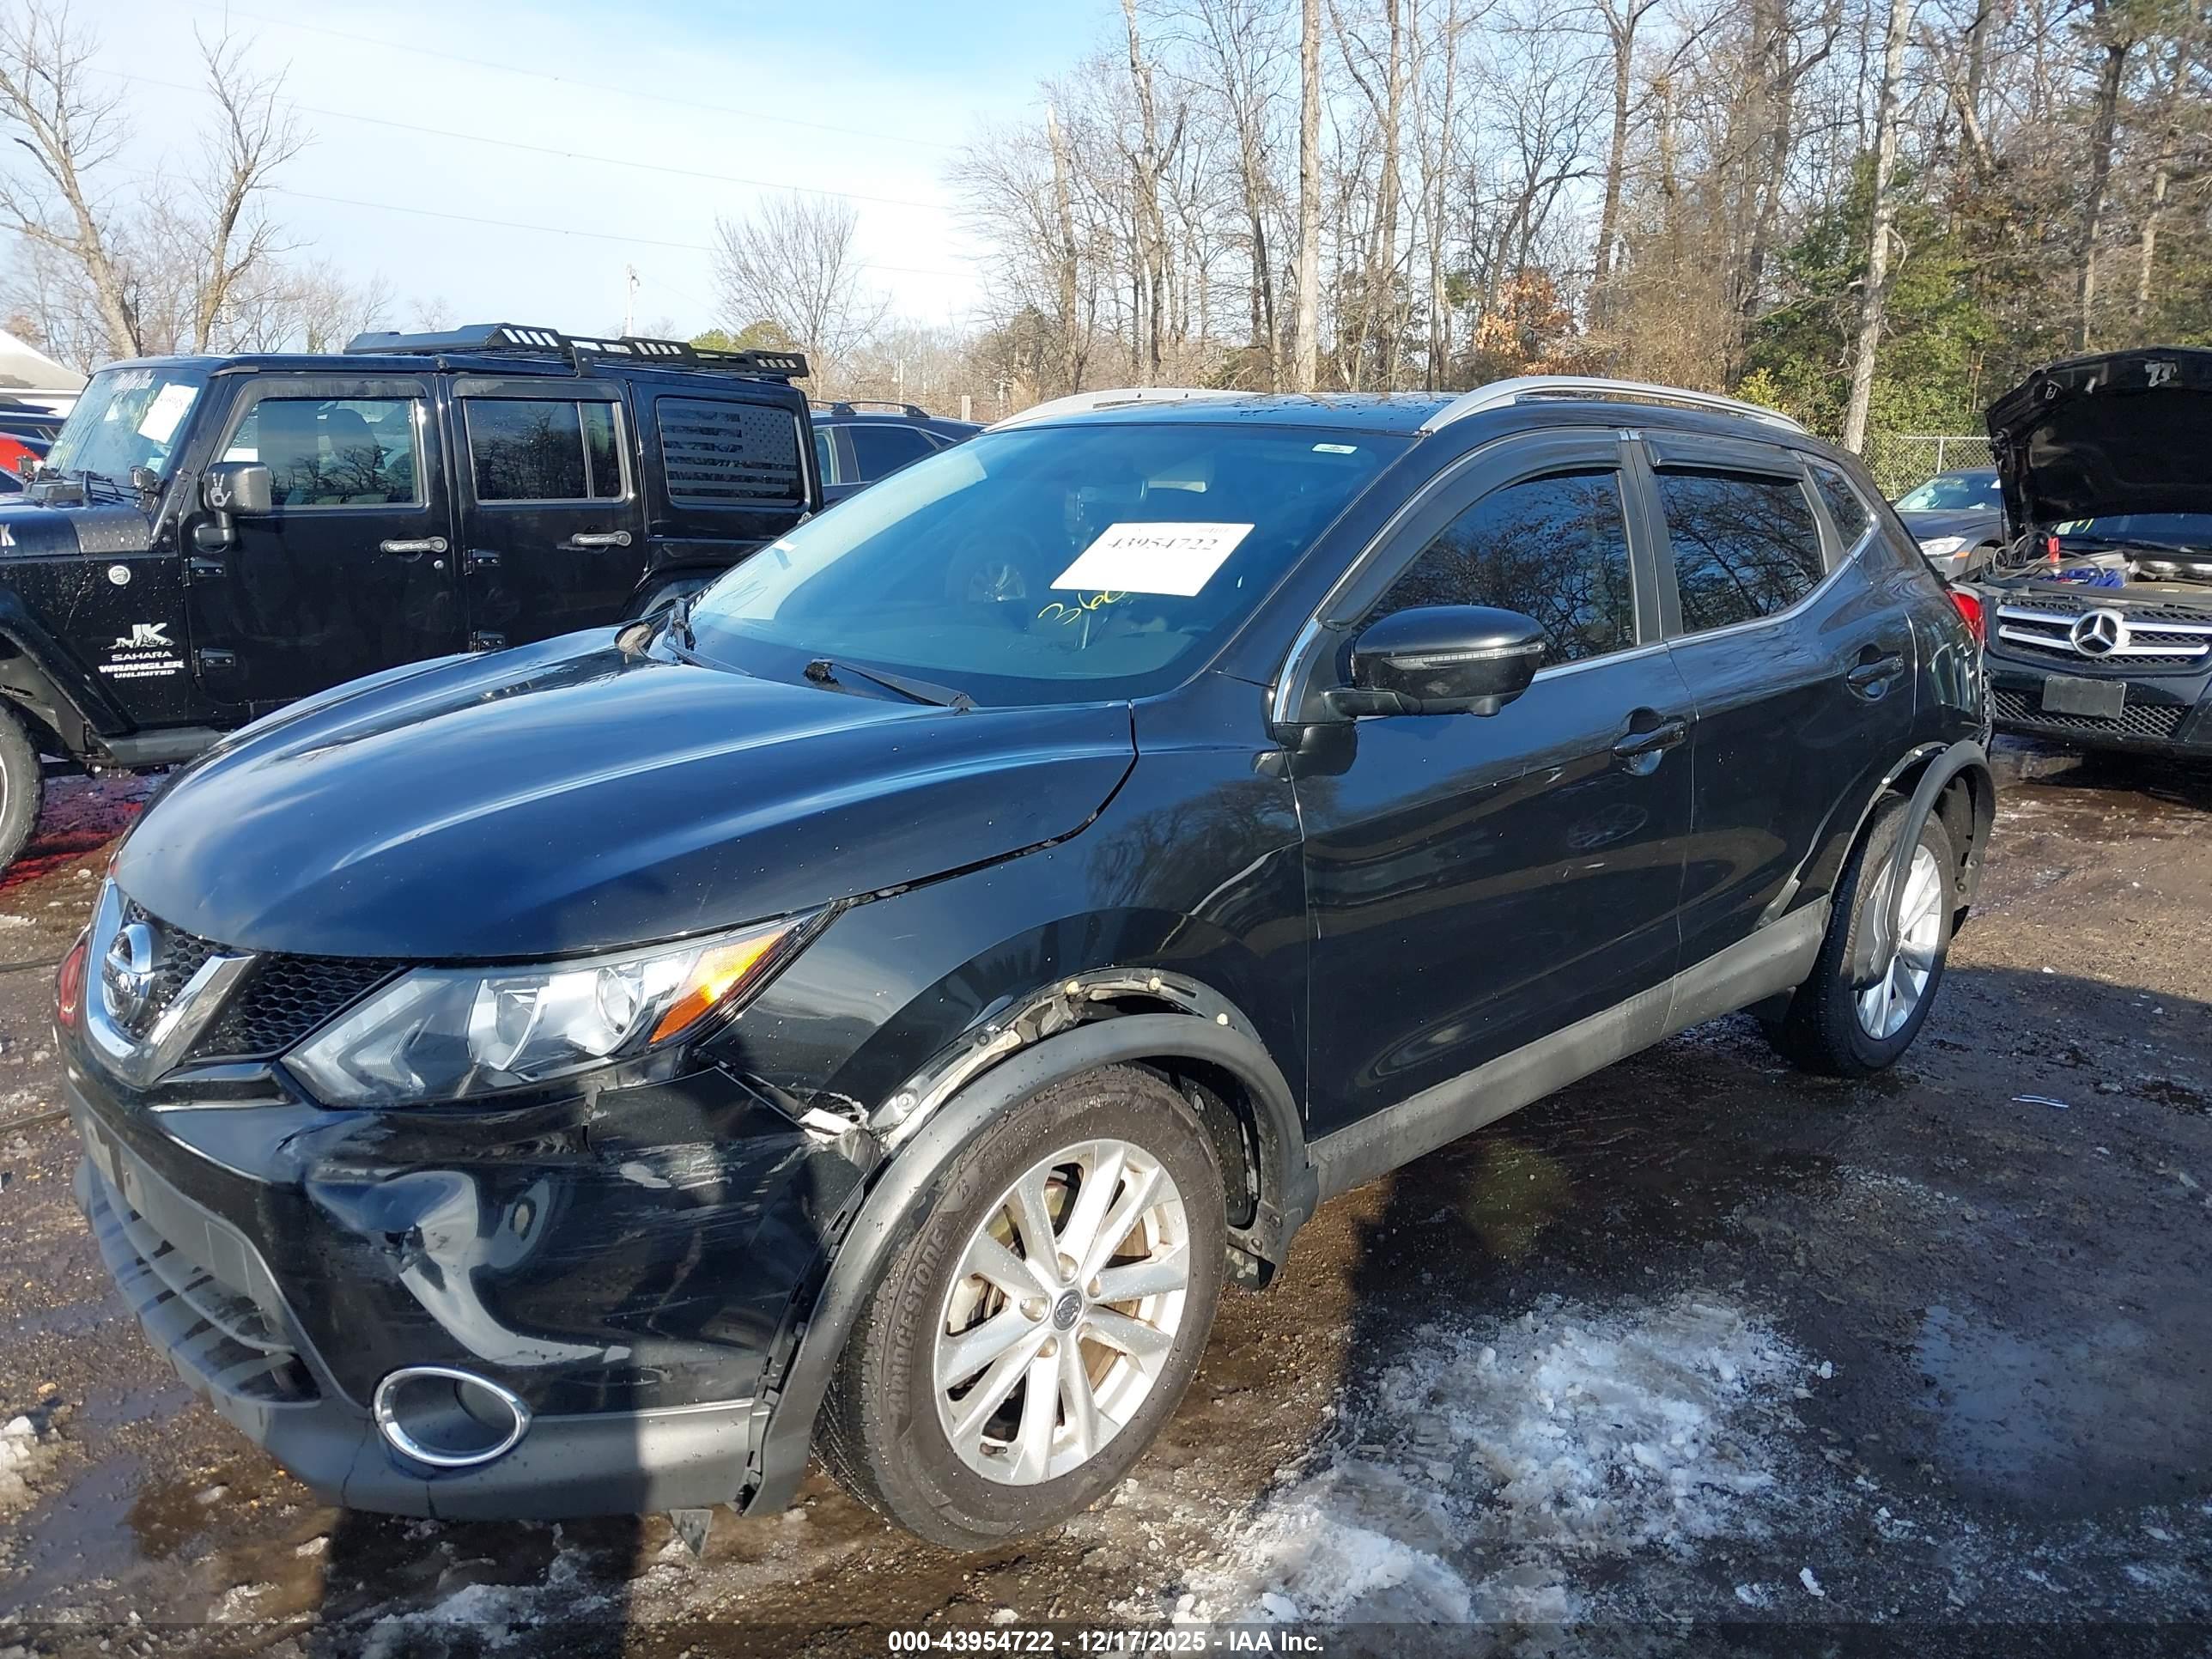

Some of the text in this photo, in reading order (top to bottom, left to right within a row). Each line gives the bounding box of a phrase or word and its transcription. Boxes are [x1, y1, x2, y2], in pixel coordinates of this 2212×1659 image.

[1107, 537, 1219, 551] 43954722
[111, 651, 173, 662] SAHARA
[98, 660, 185, 673] WRANGLER
[113, 670, 175, 678] UNLIMITED
